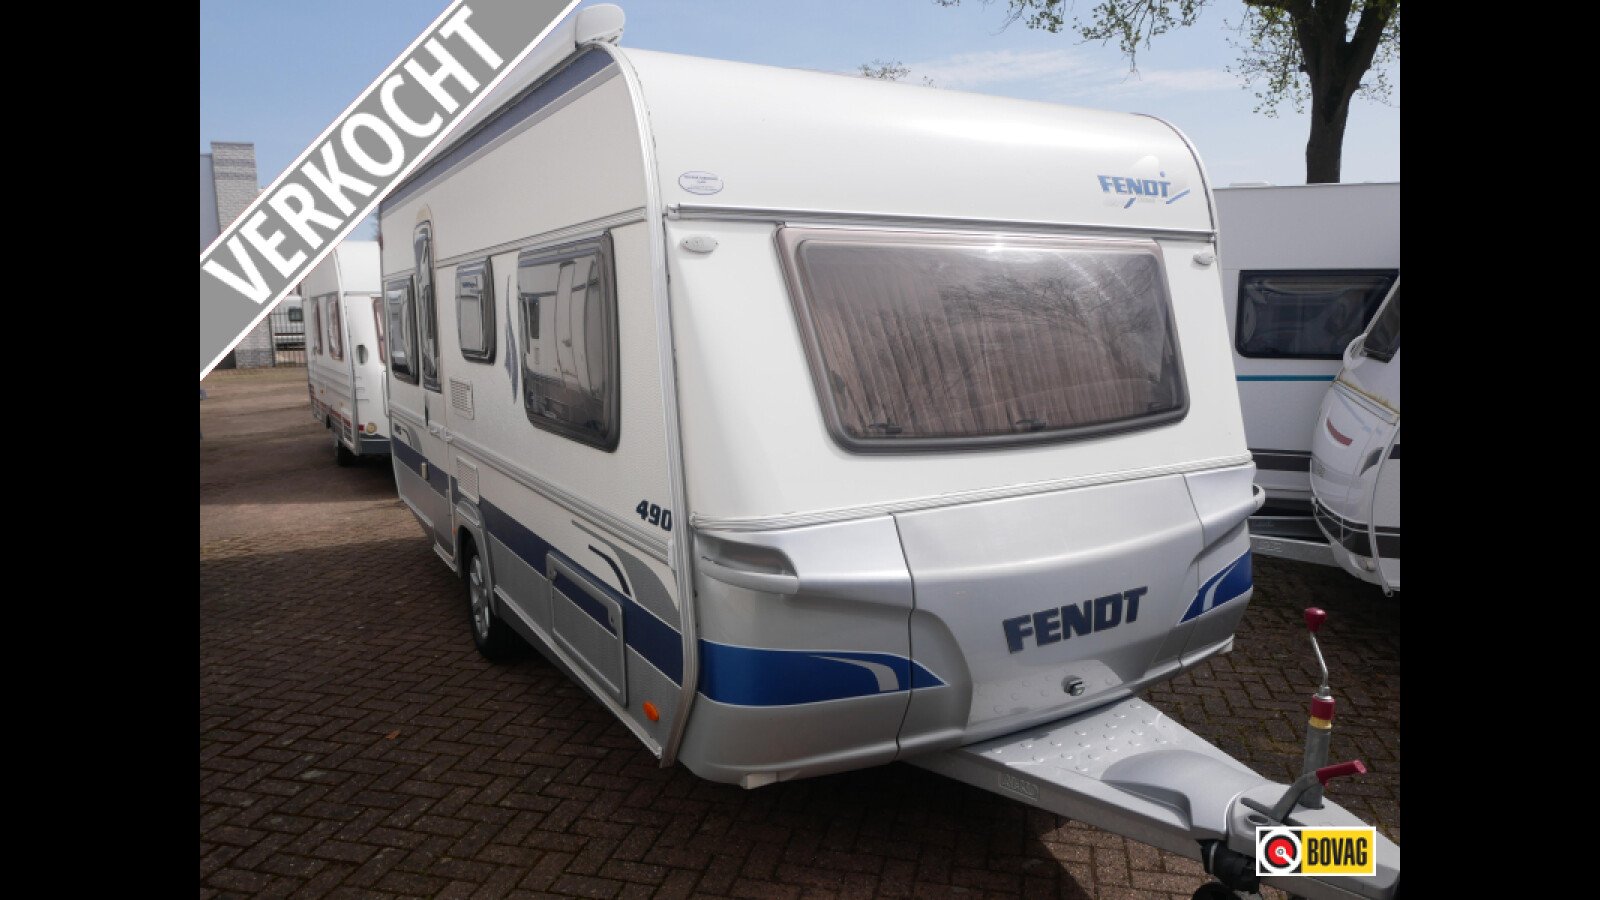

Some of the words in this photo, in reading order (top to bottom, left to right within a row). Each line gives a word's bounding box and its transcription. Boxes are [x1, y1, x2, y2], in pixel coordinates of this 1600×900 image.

[1097, 175, 1171, 197] FENDT
[636, 500, 672, 531] 490
[1002, 586, 1148, 654] FENDT
